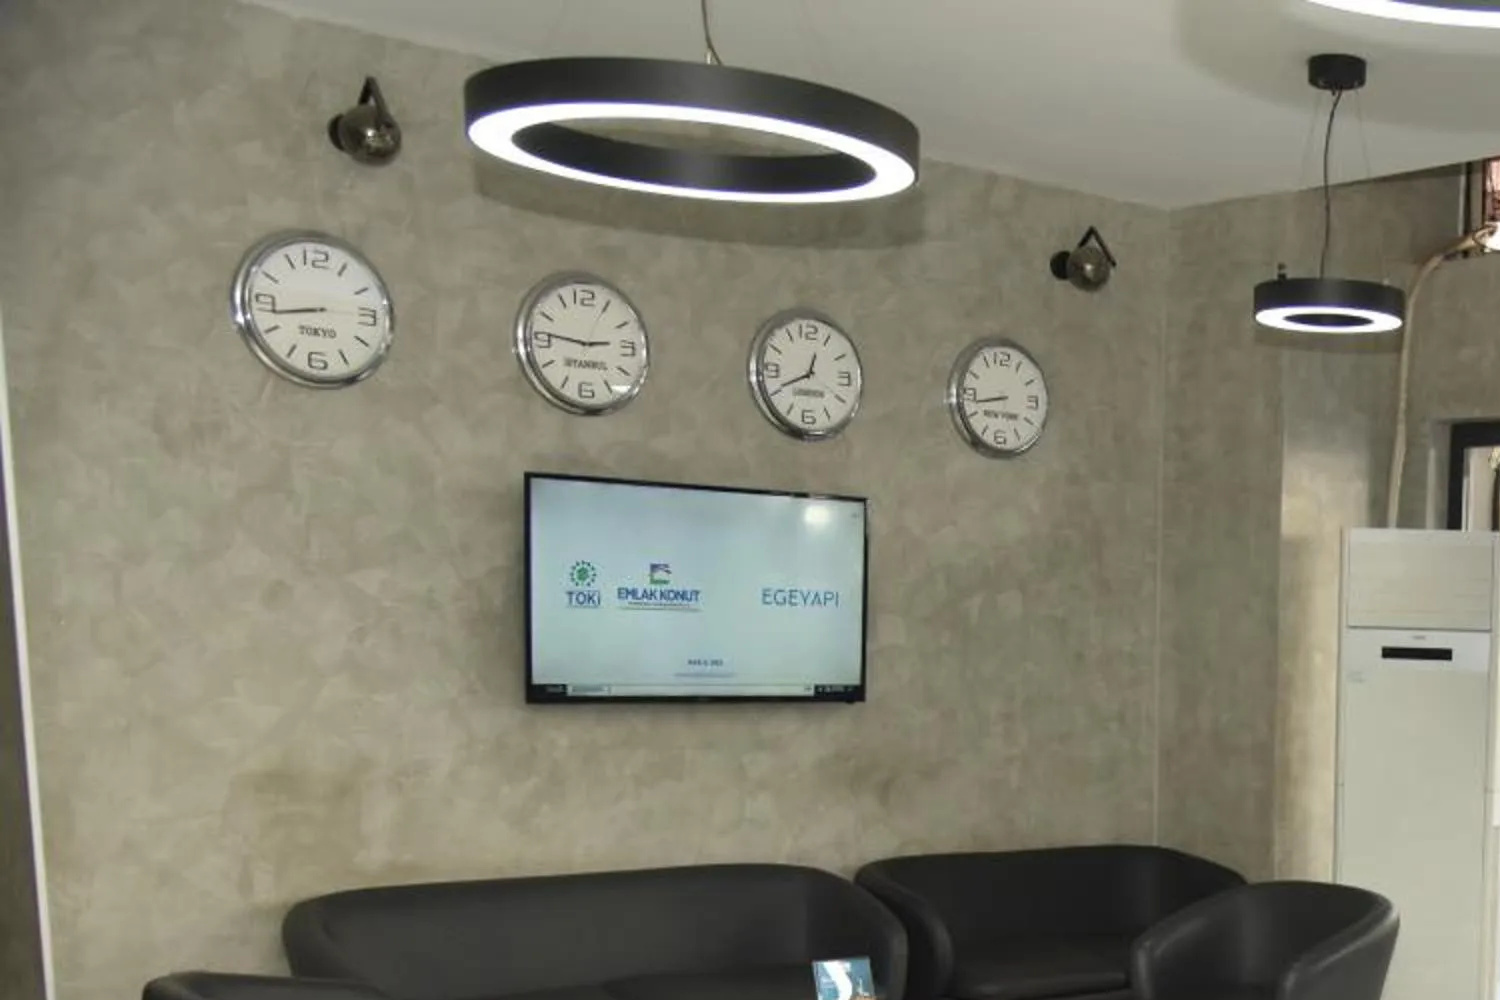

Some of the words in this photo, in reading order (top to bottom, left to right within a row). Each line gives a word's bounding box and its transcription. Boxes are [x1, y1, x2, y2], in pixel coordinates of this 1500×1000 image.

[303, 247, 330, 271] 12
[254, 293, 276, 313] 9
[572, 288, 596, 308] 12
[358, 306, 378, 327] 3
[297, 324, 338, 339] TOKYO
[533, 330, 552, 349] 9
[798, 323, 819, 341] 12
[619, 339, 636, 358] 3
[306, 351, 329, 371] 6
[993, 351, 1011, 368] 12
[764, 361, 780, 379] 9
[837, 370, 852, 388] 3
[577, 382, 596, 399] 6
[1026, 394, 1039, 411] 3
[801, 409, 817, 425] 6
[993, 429, 1008, 446] 6
[616, 586, 658, 601] EMLAK
[659, 588, 700, 603] KONUT
[761, 587, 840, 608] EGEYAPI
